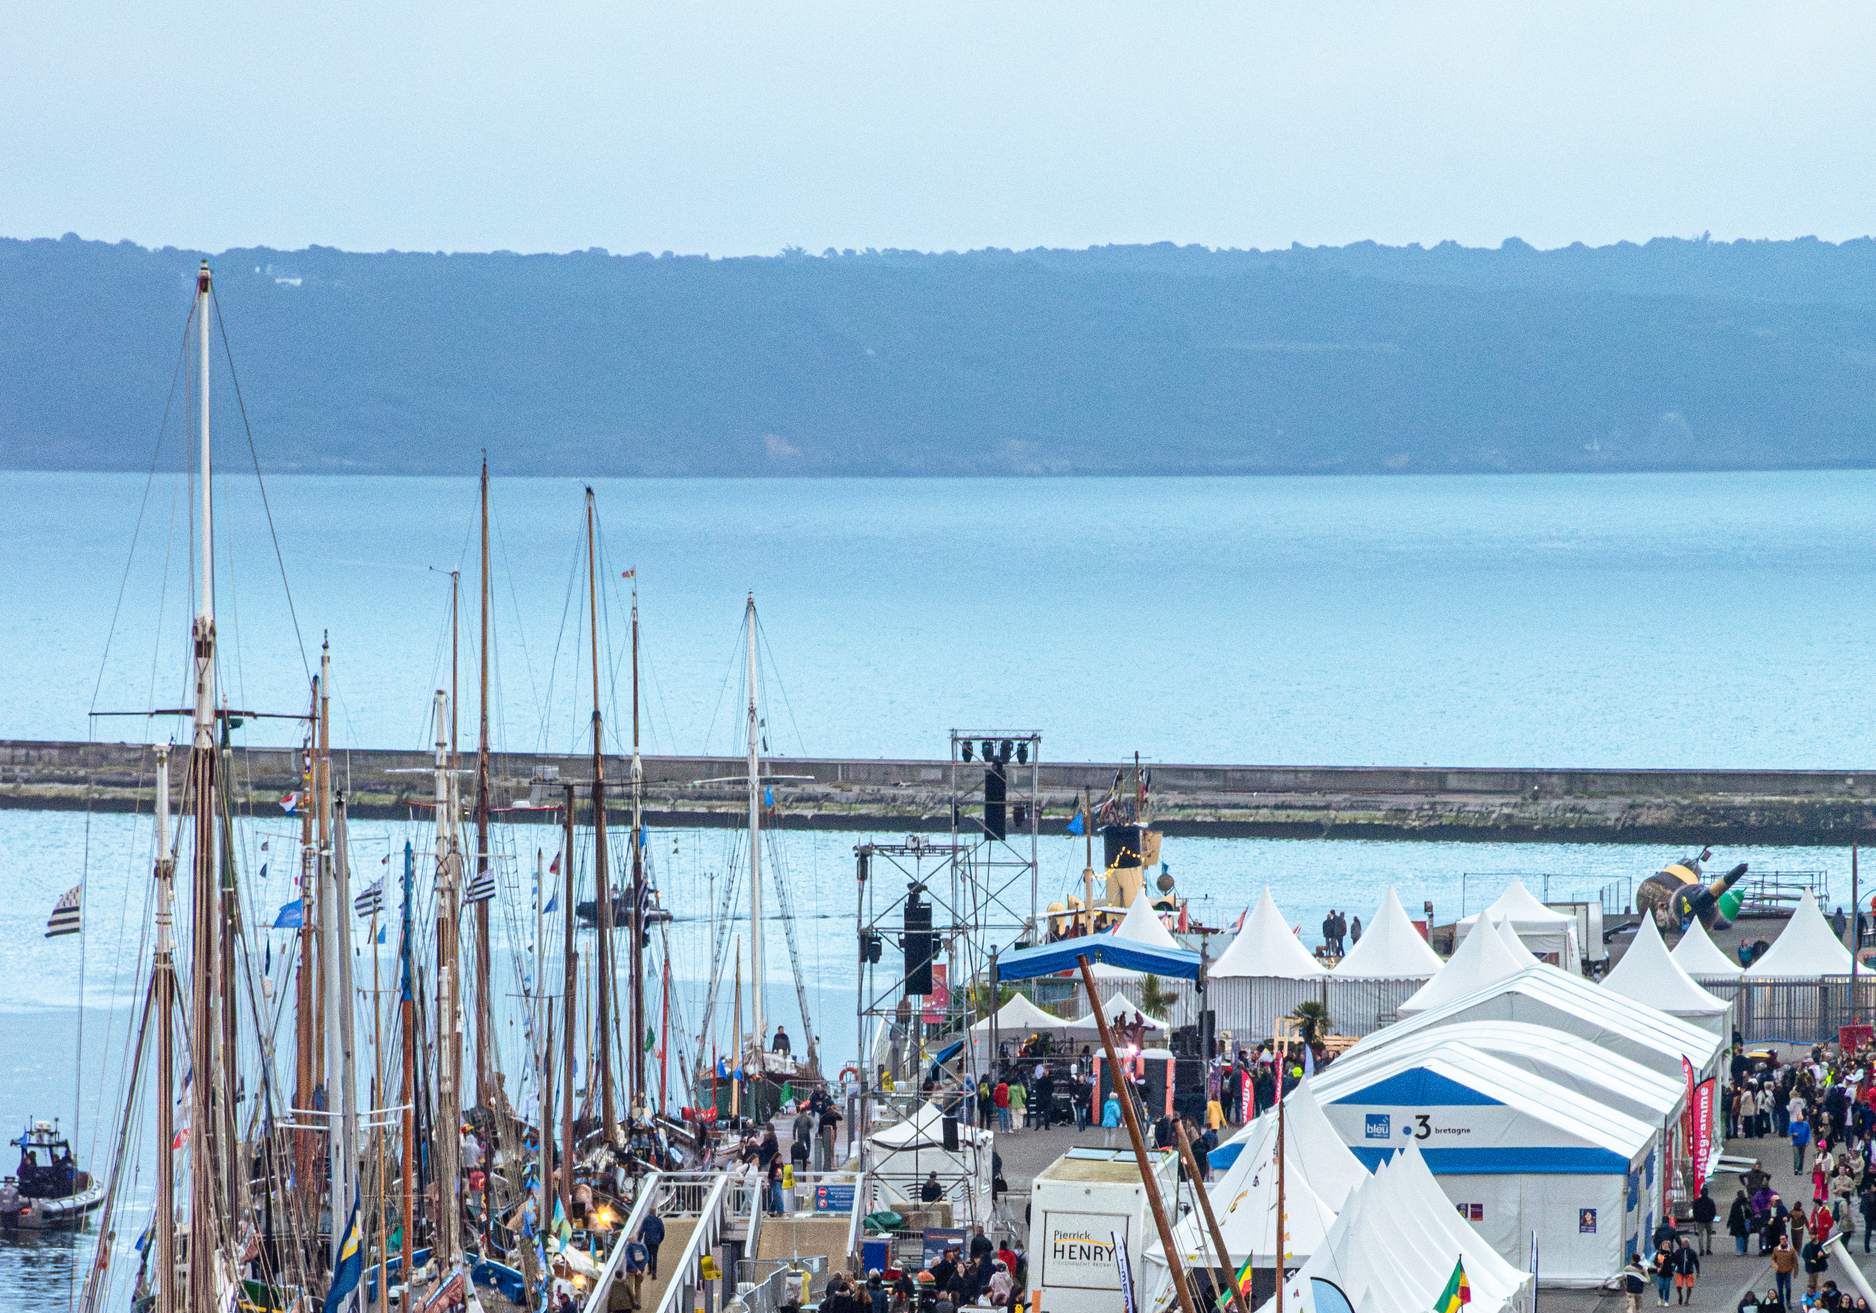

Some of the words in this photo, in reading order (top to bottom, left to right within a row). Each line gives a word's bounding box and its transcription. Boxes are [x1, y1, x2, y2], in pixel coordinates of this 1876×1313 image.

[1366, 1123, 1389, 1134] bleu
[1414, 1114, 1432, 1140] 3
[1434, 1126, 1471, 1136] bretagne
[1696, 1086, 1709, 1180] Télégramme
[1053, 1229, 1091, 1241] Pierrick
[1053, 1244, 1115, 1262] HENRY
